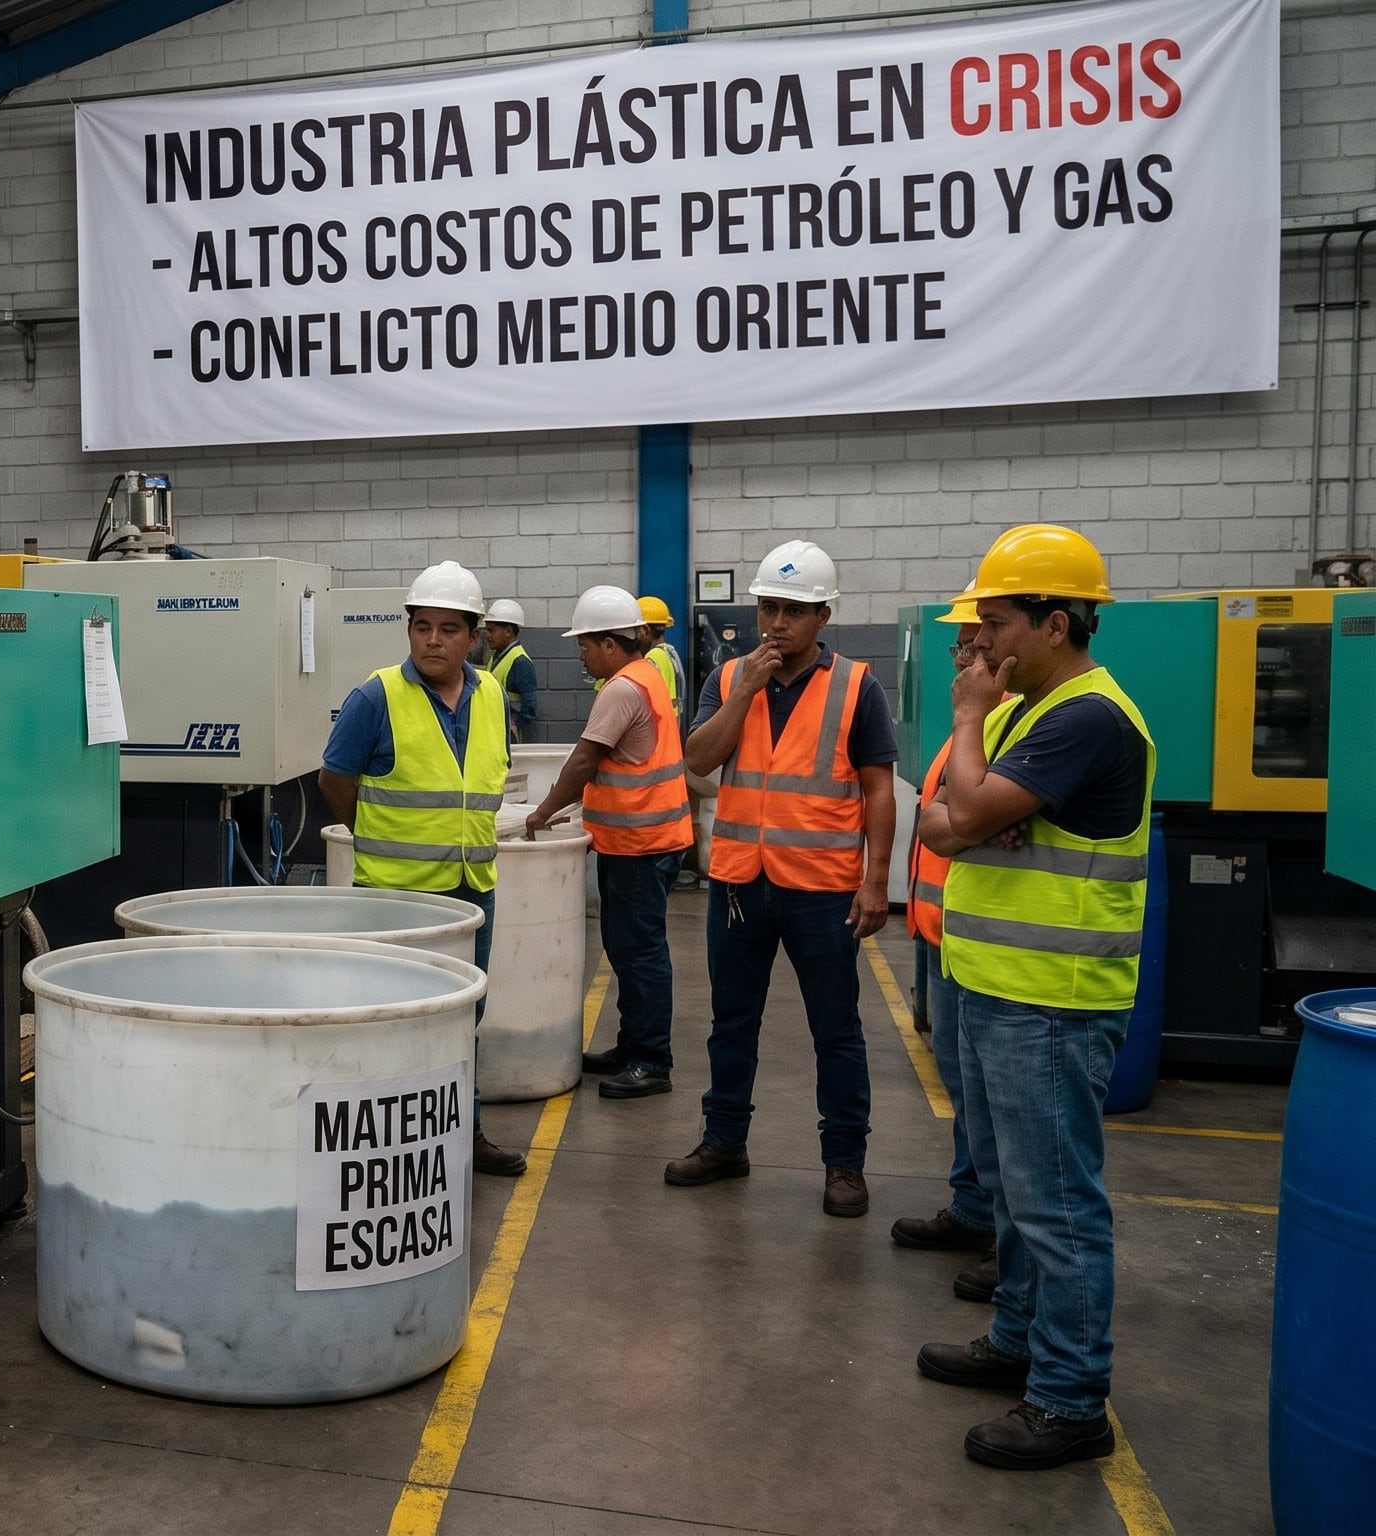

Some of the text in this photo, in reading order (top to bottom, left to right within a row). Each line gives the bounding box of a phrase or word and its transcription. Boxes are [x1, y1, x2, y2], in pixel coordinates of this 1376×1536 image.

[144, 38, 1183, 205] INDUSTRIA PLÁSTICA EN CRISIS
[188, 220, 348, 293] ALTOS
[365, 202, 572, 281] COSTOS
[592, 194, 661, 264] DE
[680, 164, 976, 258] PETRÓLEO
[993, 165, 1034, 234] Y
[1053, 153, 1173, 230] GAS
[190, 303, 478, 384] CONFLICTO
[498, 290, 676, 366] MEDIO
[696, 271, 947, 354] ORIENTE
[314, 1080, 461, 1153] MATERIA
[340, 1143, 447, 1212] PRIMA
[325, 1199, 453, 1273] ESCASA
